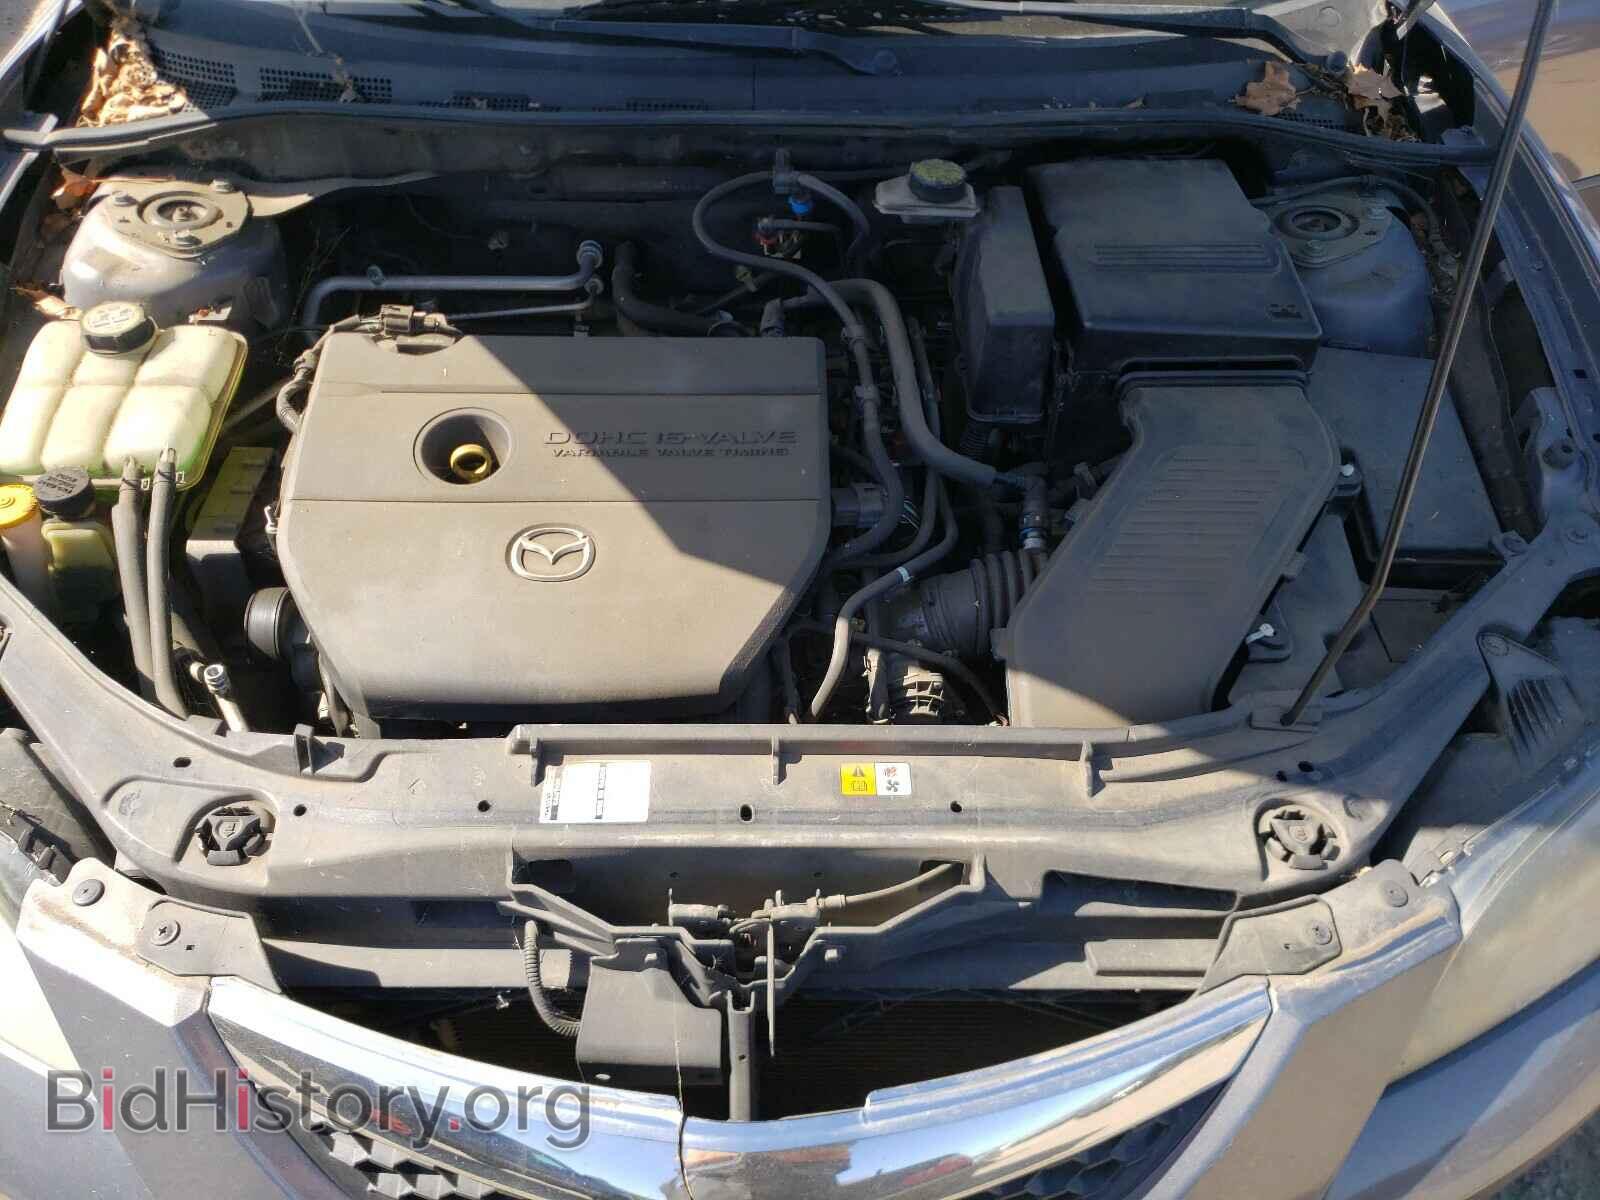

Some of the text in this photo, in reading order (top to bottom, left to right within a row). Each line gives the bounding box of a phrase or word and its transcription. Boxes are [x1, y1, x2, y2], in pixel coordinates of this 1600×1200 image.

[544, 431, 798, 445] DOHC 16-VALVE
[657, 448, 714, 458] VALVE
